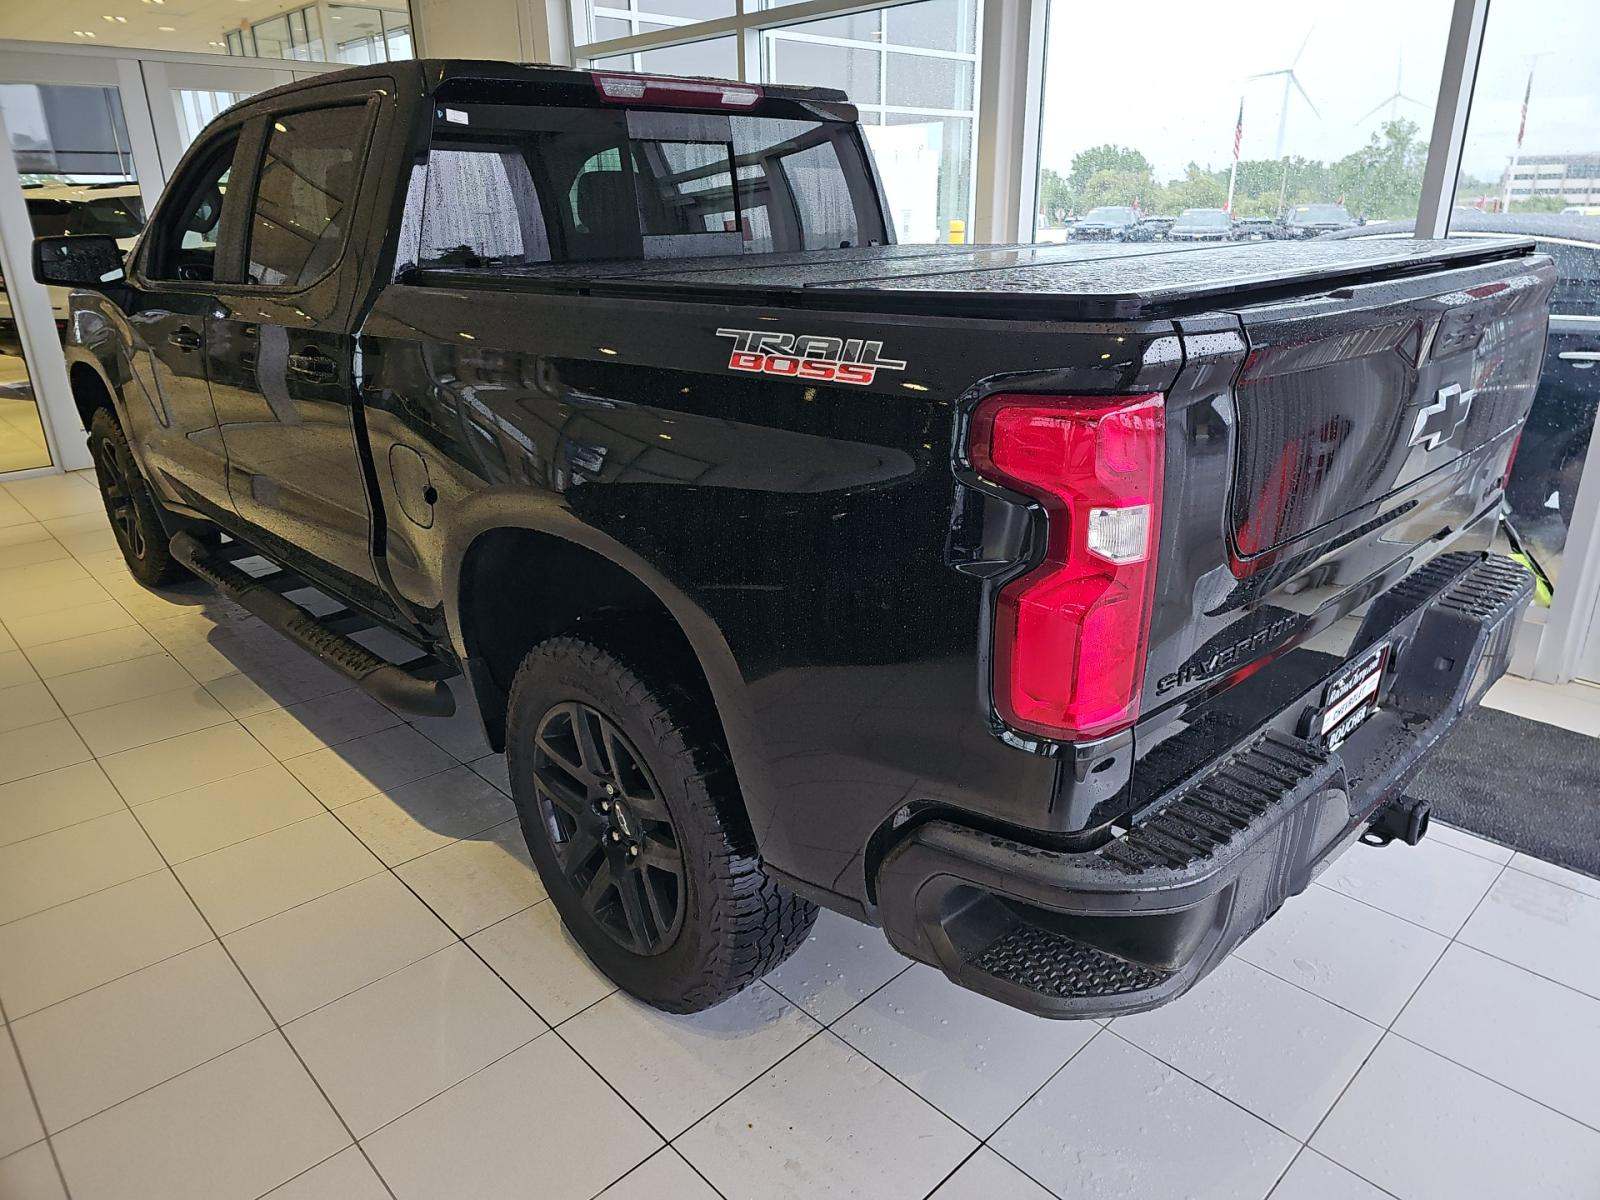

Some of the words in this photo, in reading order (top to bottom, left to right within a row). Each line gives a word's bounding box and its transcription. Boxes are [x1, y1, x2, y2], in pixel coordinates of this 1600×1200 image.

[716, 328, 907, 370] TRAIL
[728, 350, 877, 385] BOSS
[1156, 613, 1299, 696] SILVERADO
[1328, 705, 1368, 748] BOUCHER
